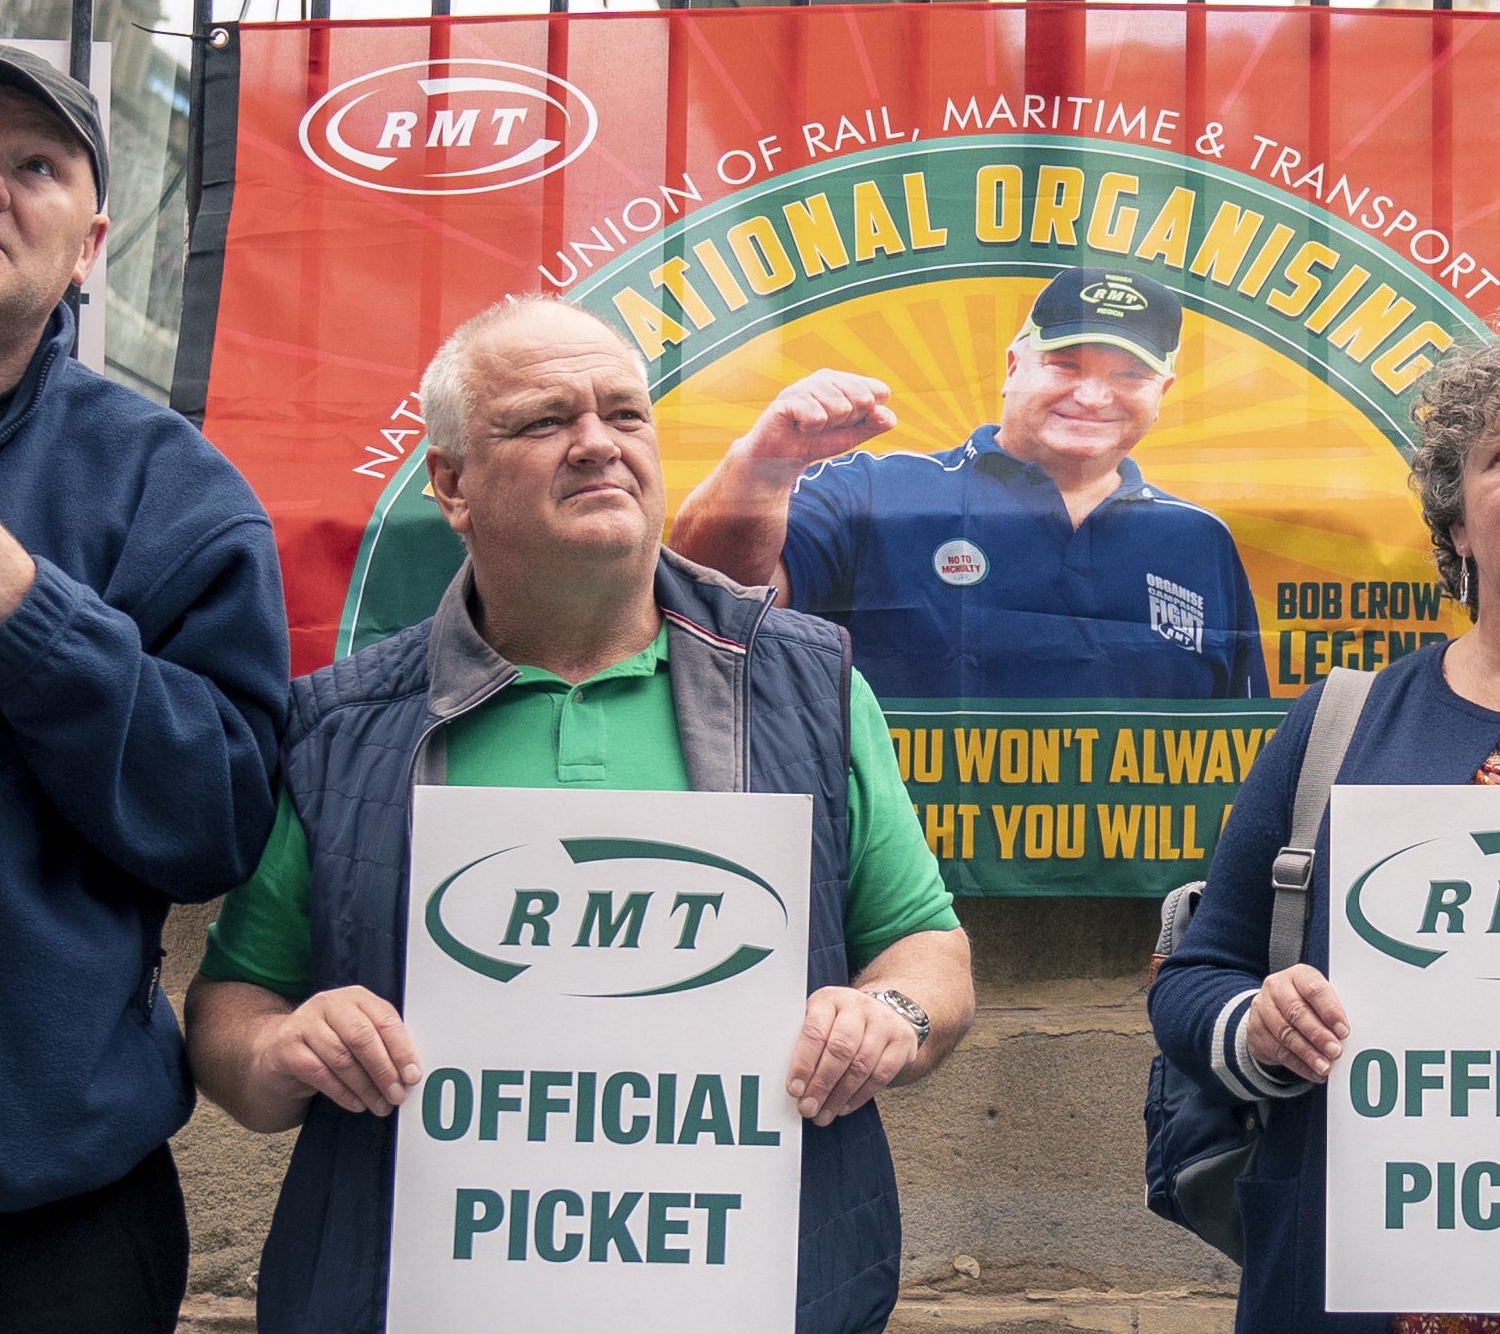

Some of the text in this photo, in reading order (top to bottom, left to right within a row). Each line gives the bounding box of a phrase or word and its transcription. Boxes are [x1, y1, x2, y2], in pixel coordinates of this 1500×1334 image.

[377, 107, 529, 149] RMT
[352, 94, 1500, 479] NAT UNION OF RAIL, MARITIME & TRANSPORT
[611, 164, 1456, 397] ATIONAL ORGANISING
[1093, 288, 1138, 305] RMT
[961, 555, 972, 564] TO
[1146, 572, 1205, 608] ORGANISE
[1277, 581, 1443, 621] BOB CROW
[1149, 597, 1205, 654] FIGHT
[1166, 628, 1192, 646] RMT
[1277, 630, 1449, 686] LEGE
[891, 727, 1279, 785] OU WON'T ALWAY
[922, 803, 981, 860] HT
[993, 803, 1086, 860] YOU
[1097, 803, 1205, 860] WILL
[499, 889, 725, 950] RMT
[421, 1066, 783, 1148] OFFICIAL
[451, 1187, 743, 1267] PICKET
